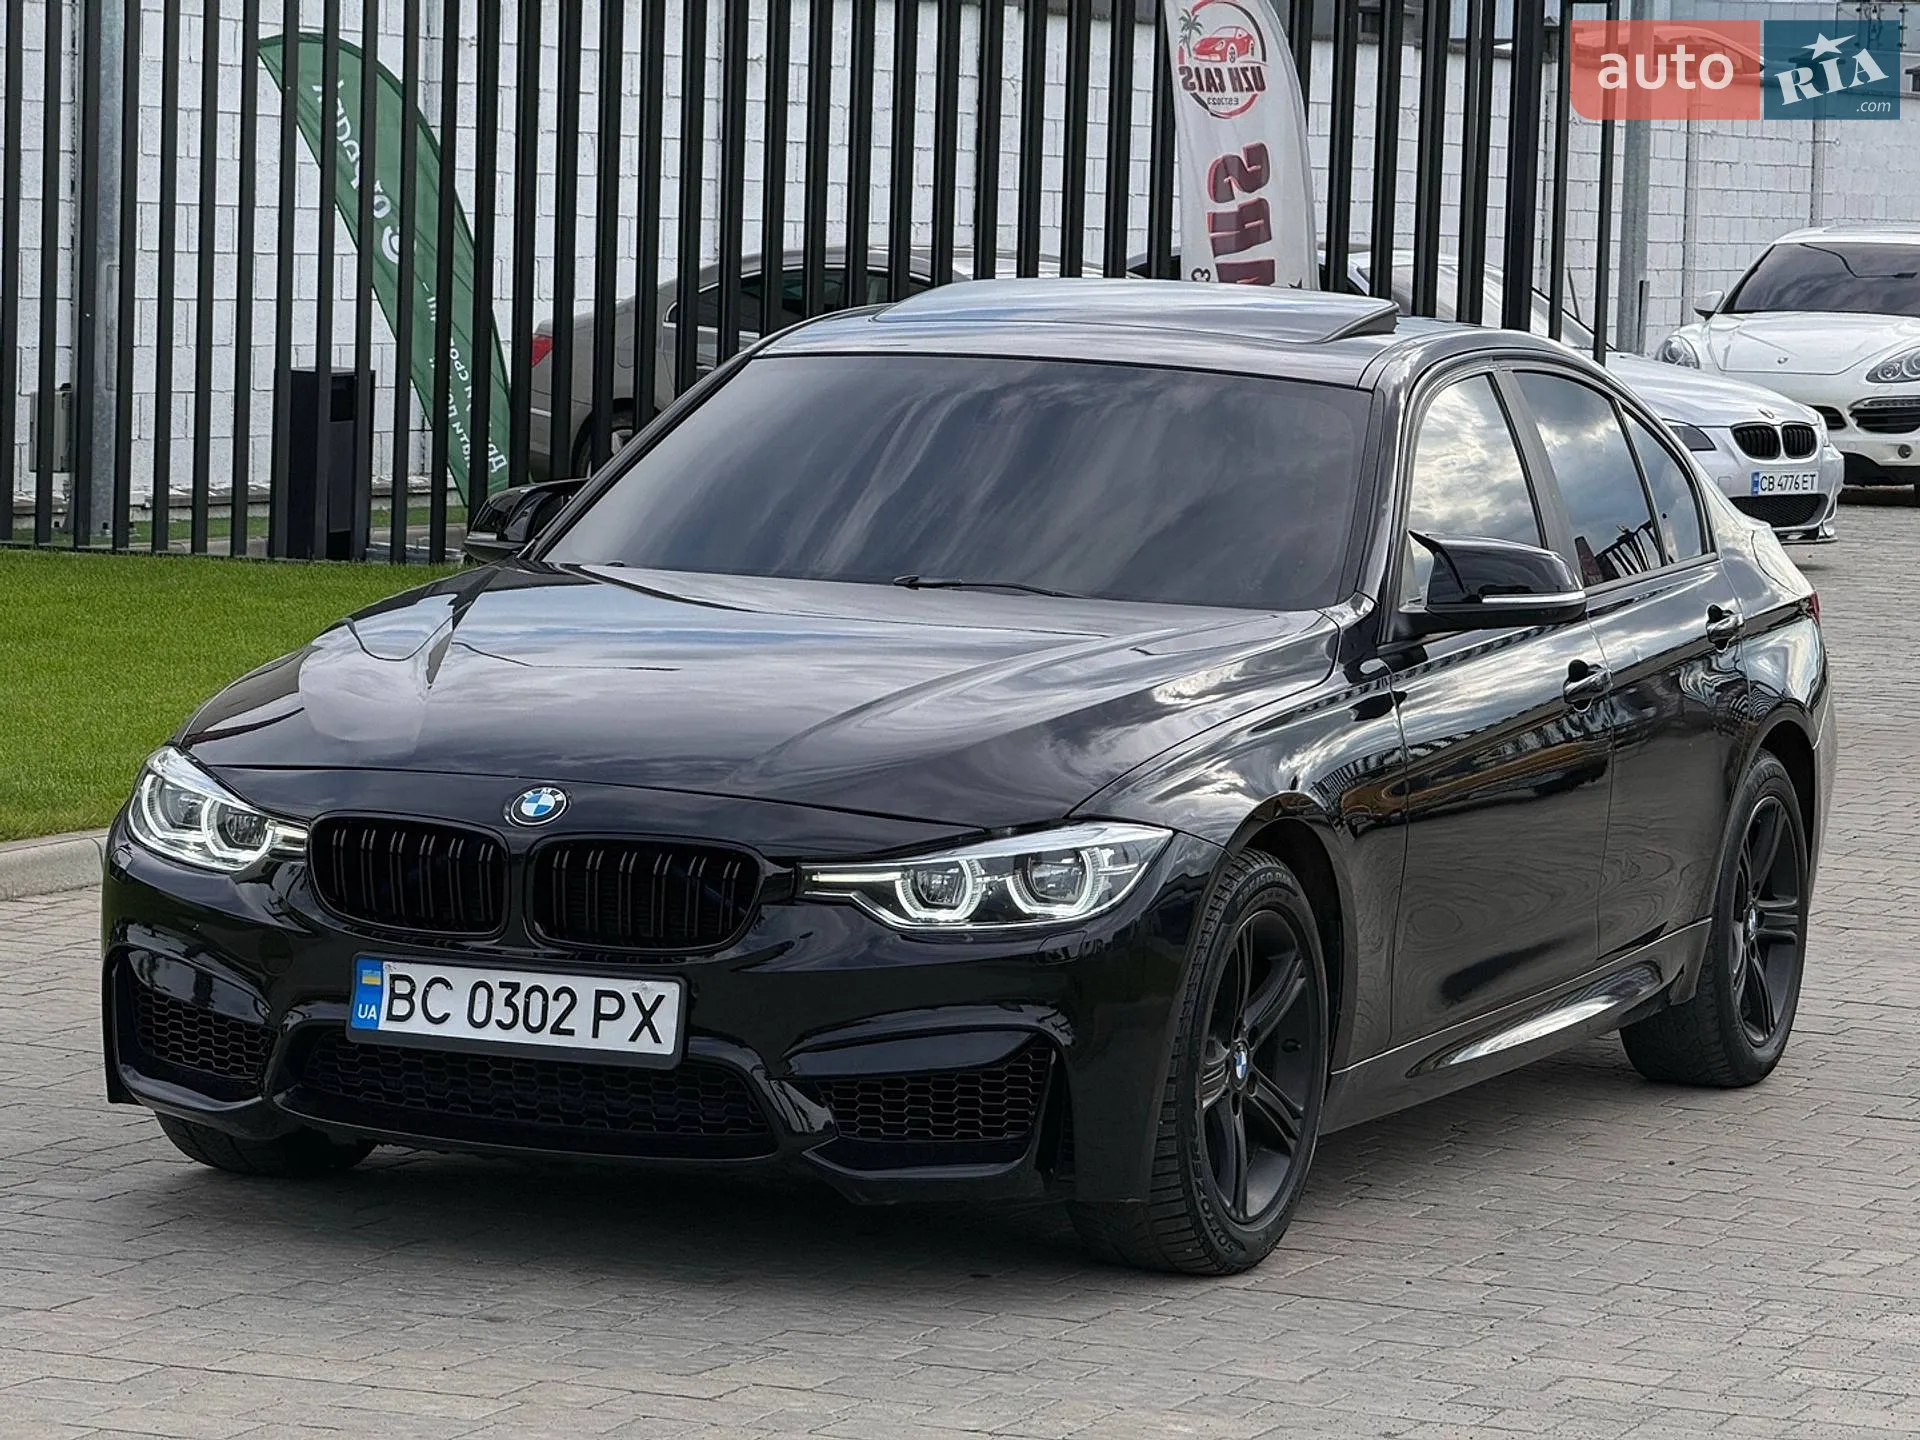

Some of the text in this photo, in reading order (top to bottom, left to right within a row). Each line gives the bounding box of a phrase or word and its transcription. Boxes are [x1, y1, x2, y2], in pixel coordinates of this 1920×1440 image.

[1760, 475, 1775, 491] CB
[1777, 474, 1800, 490] 4776
[1802, 474, 1816, 490] ET
[357, 1003, 378, 1020] UA
[385, 973, 666, 1044] BC 0302 PX
